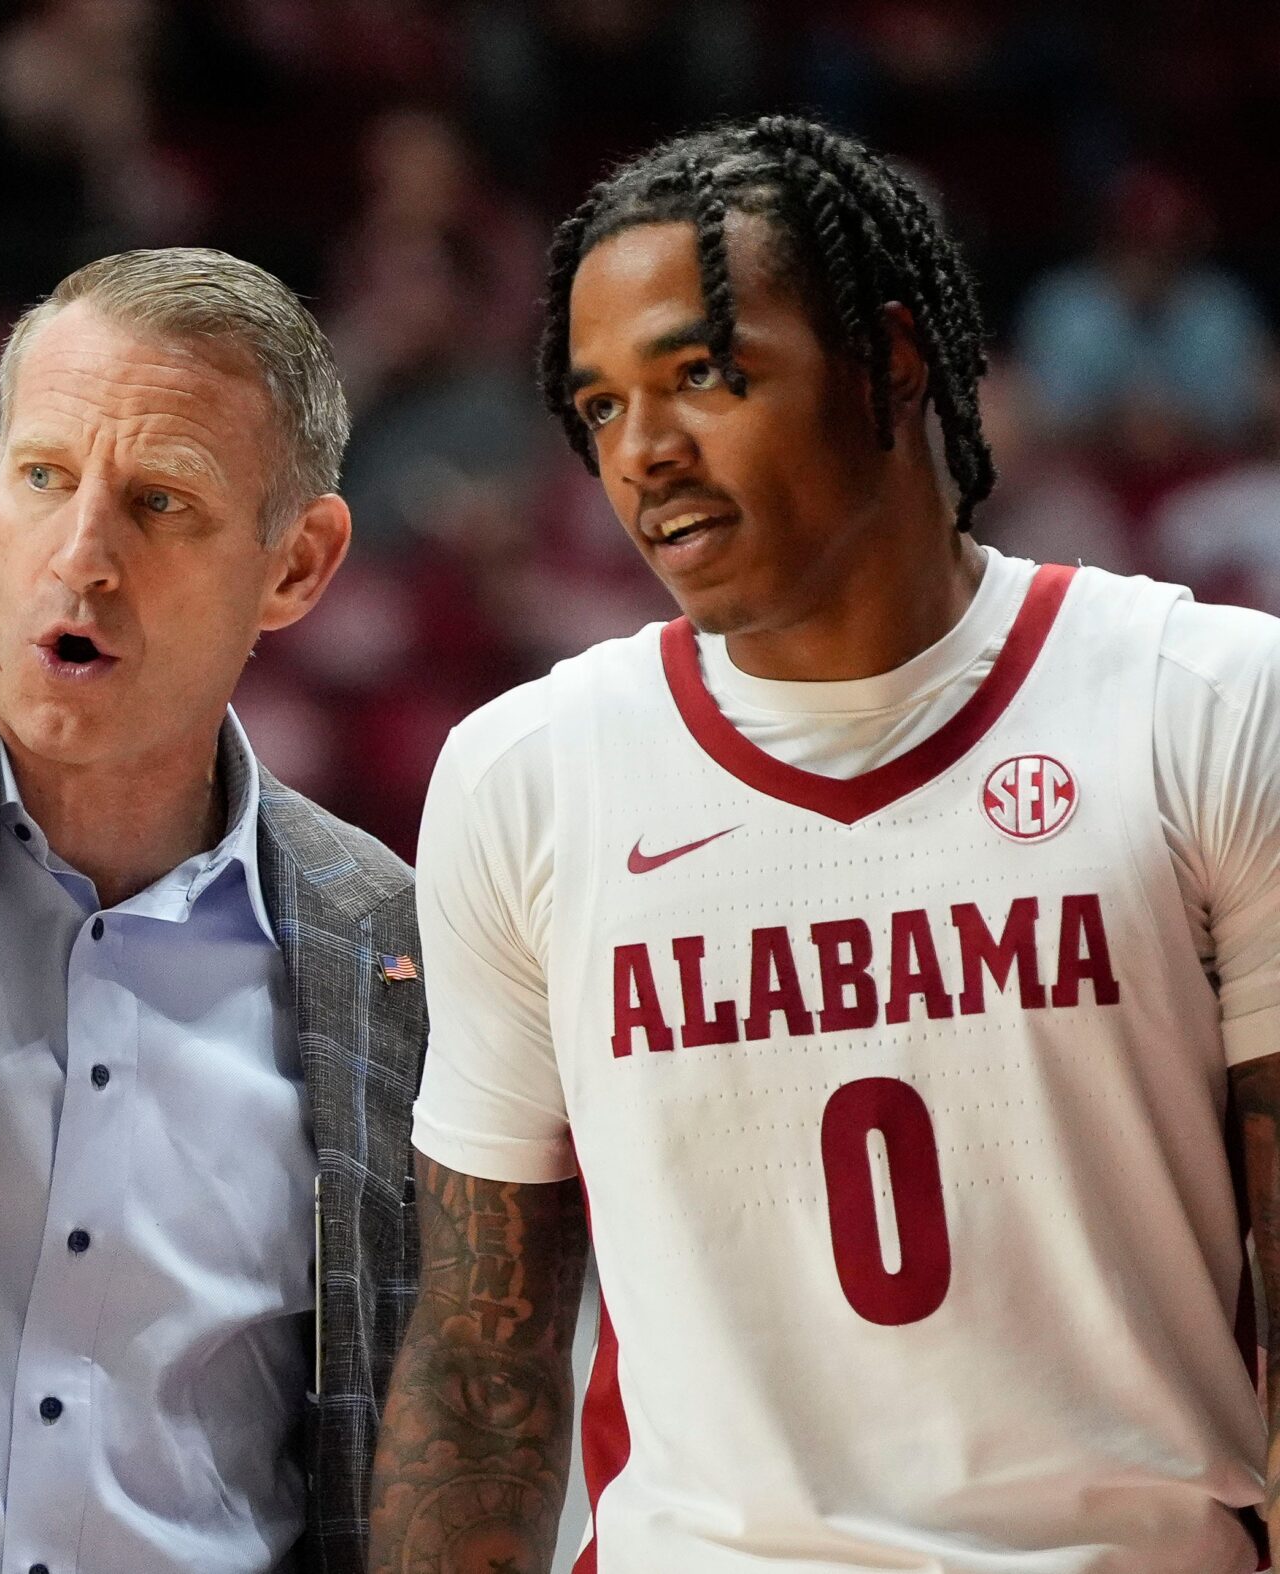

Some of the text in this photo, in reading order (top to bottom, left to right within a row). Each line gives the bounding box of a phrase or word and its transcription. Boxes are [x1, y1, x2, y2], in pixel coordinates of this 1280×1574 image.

[984, 755, 1074, 838] SEC
[611, 893, 1120, 1058] ALABAMA
[821, 1076, 951, 1326] 0
